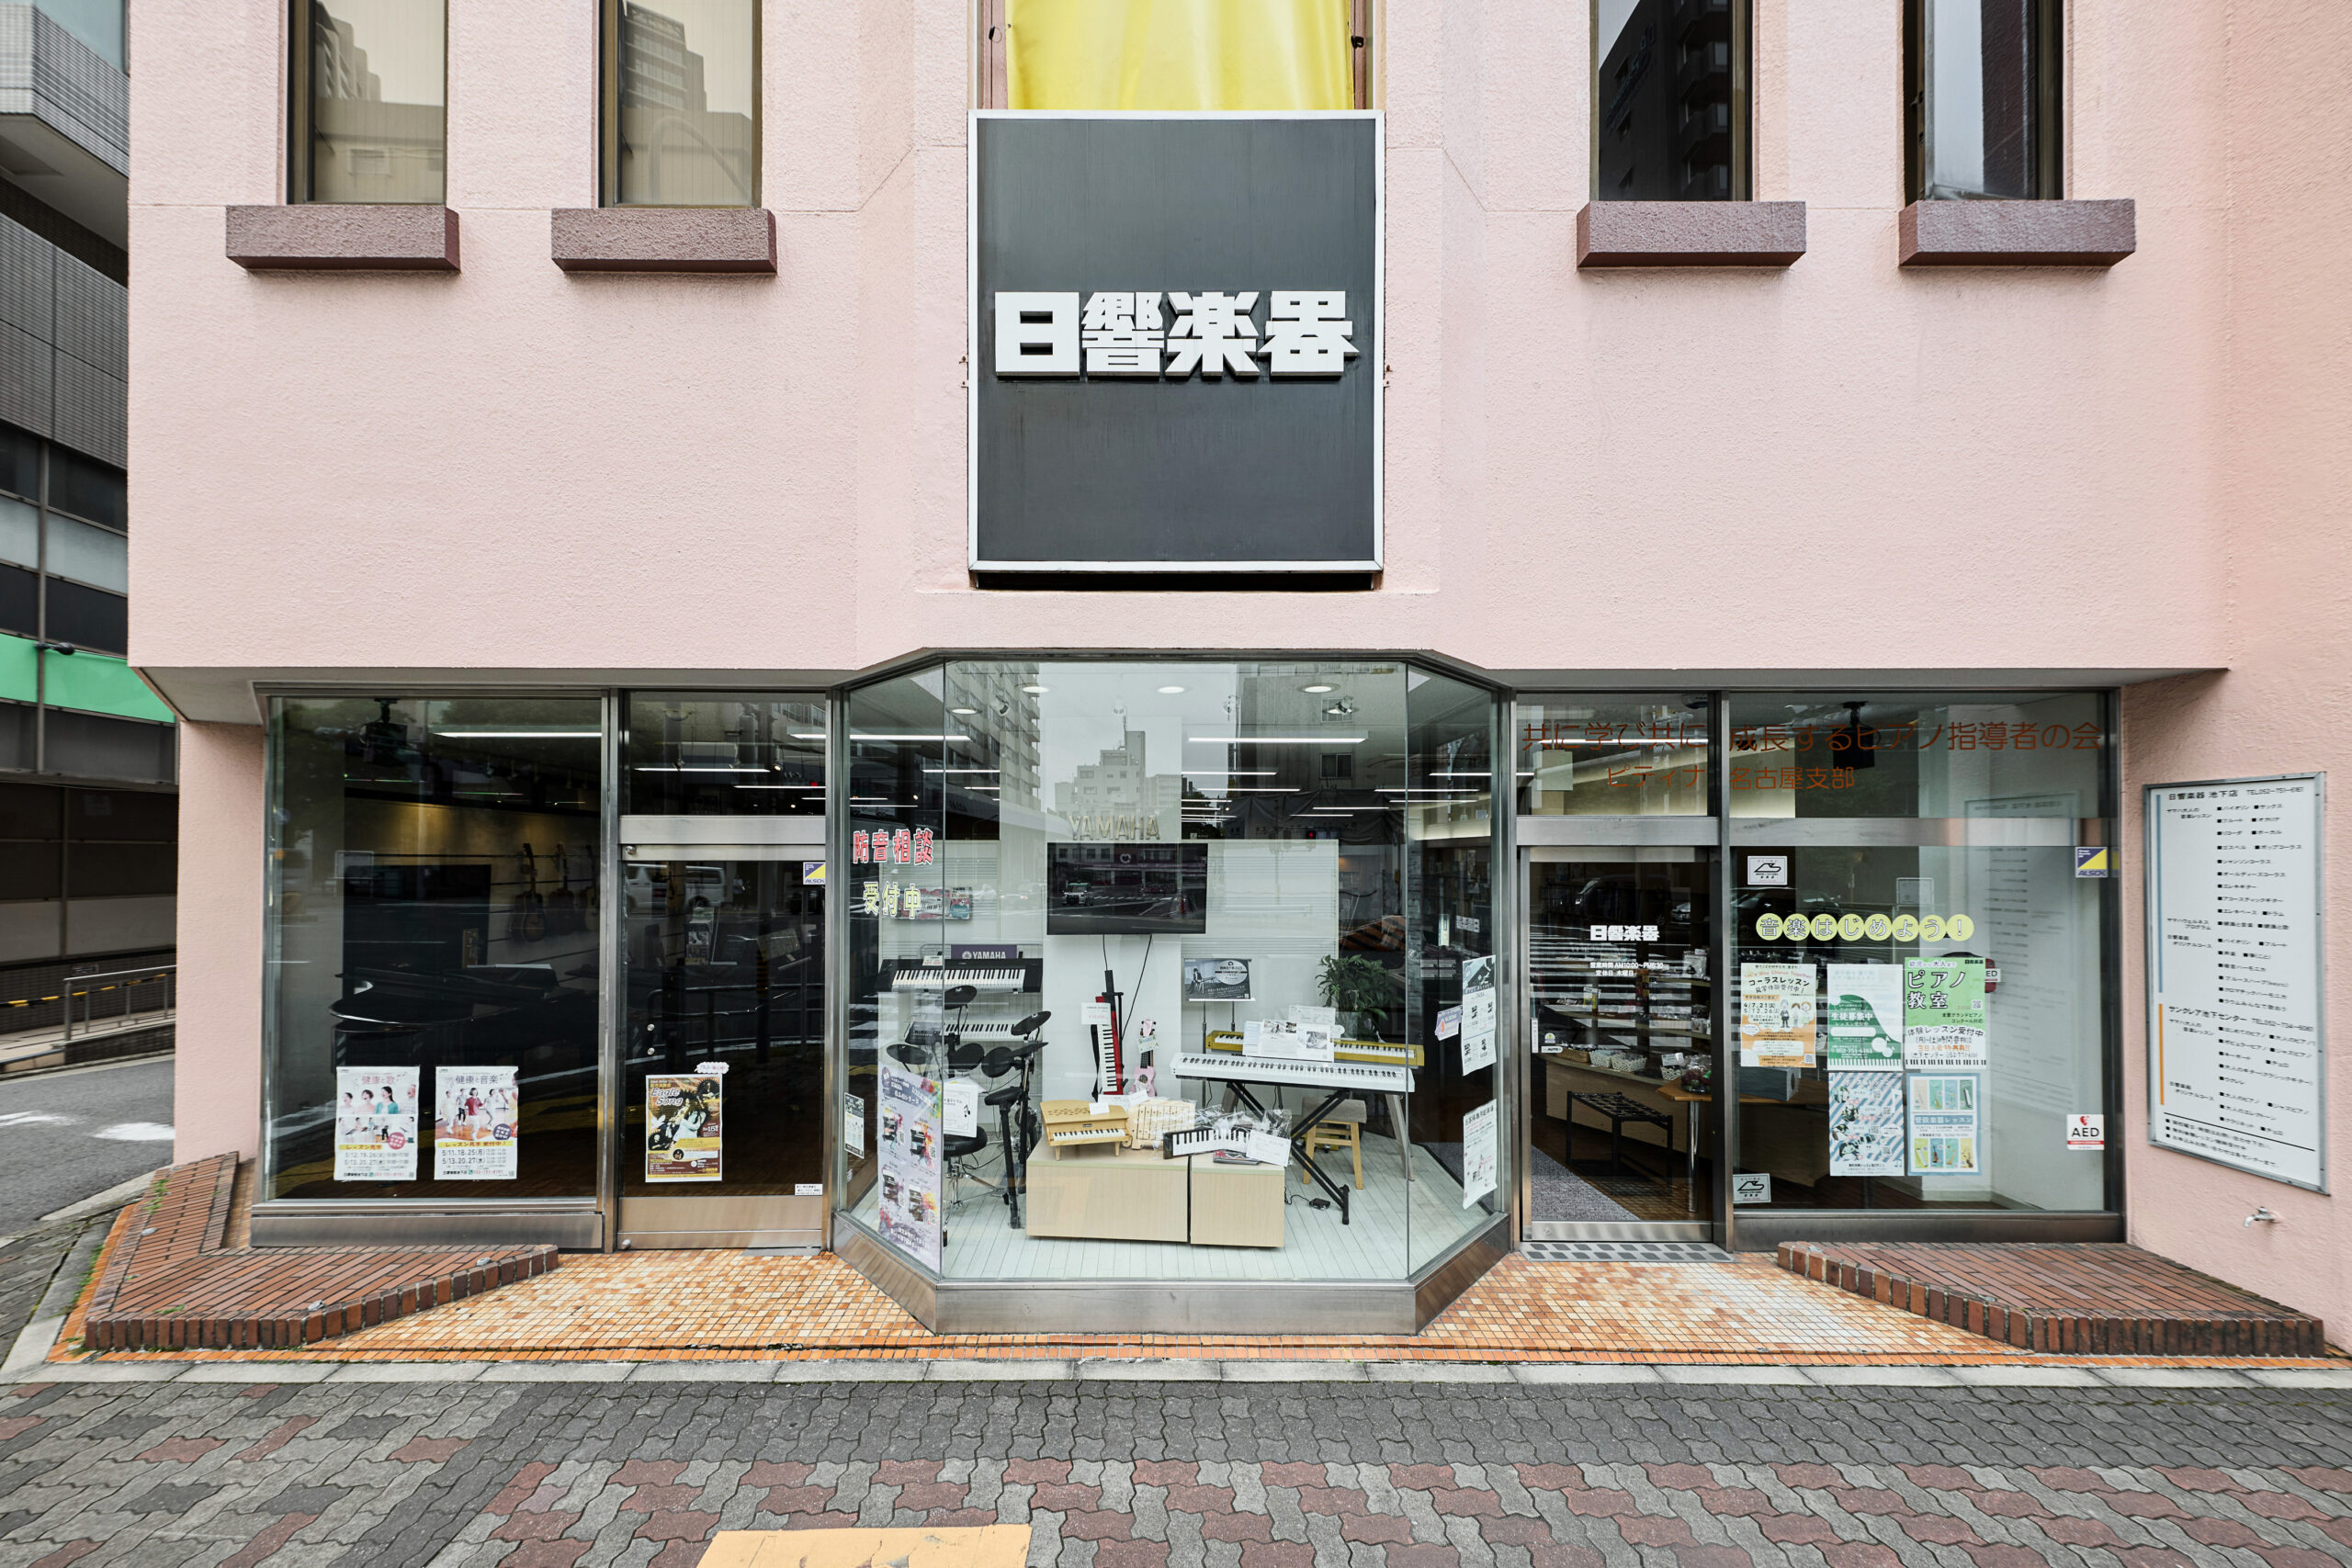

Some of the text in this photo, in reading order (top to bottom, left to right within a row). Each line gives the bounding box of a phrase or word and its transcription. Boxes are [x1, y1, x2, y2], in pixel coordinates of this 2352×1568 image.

[994, 290, 1360, 378] 日響楽器
[1522, 721, 2103, 751] 共に学び共に 成長するピアノ指導者の会
[1609, 764, 1855, 790] ピティナ 名古屋支部
[1069, 816, 1160, 840] YAMAHA
[853, 829, 933, 865] 防音相談
[863, 881, 921, 919] 受付中
[1590, 925, 1660, 942] 日響楽器
[972, 951, 1006, 959] YAMAHA
[1748, 976, 1810, 987] コーラスレッスン
[1907, 970, 1966, 989] ピアノ
[1907, 991, 1949, 1010] 教室
[1831, 1012, 1873, 1021] 生徒募集中
[456, 1075, 499, 1085] 健康と音楽
[650, 1088, 681, 1098] Eagle
[656, 1096, 684, 1107] Song
[2071, 1127, 2099, 1137] AED
